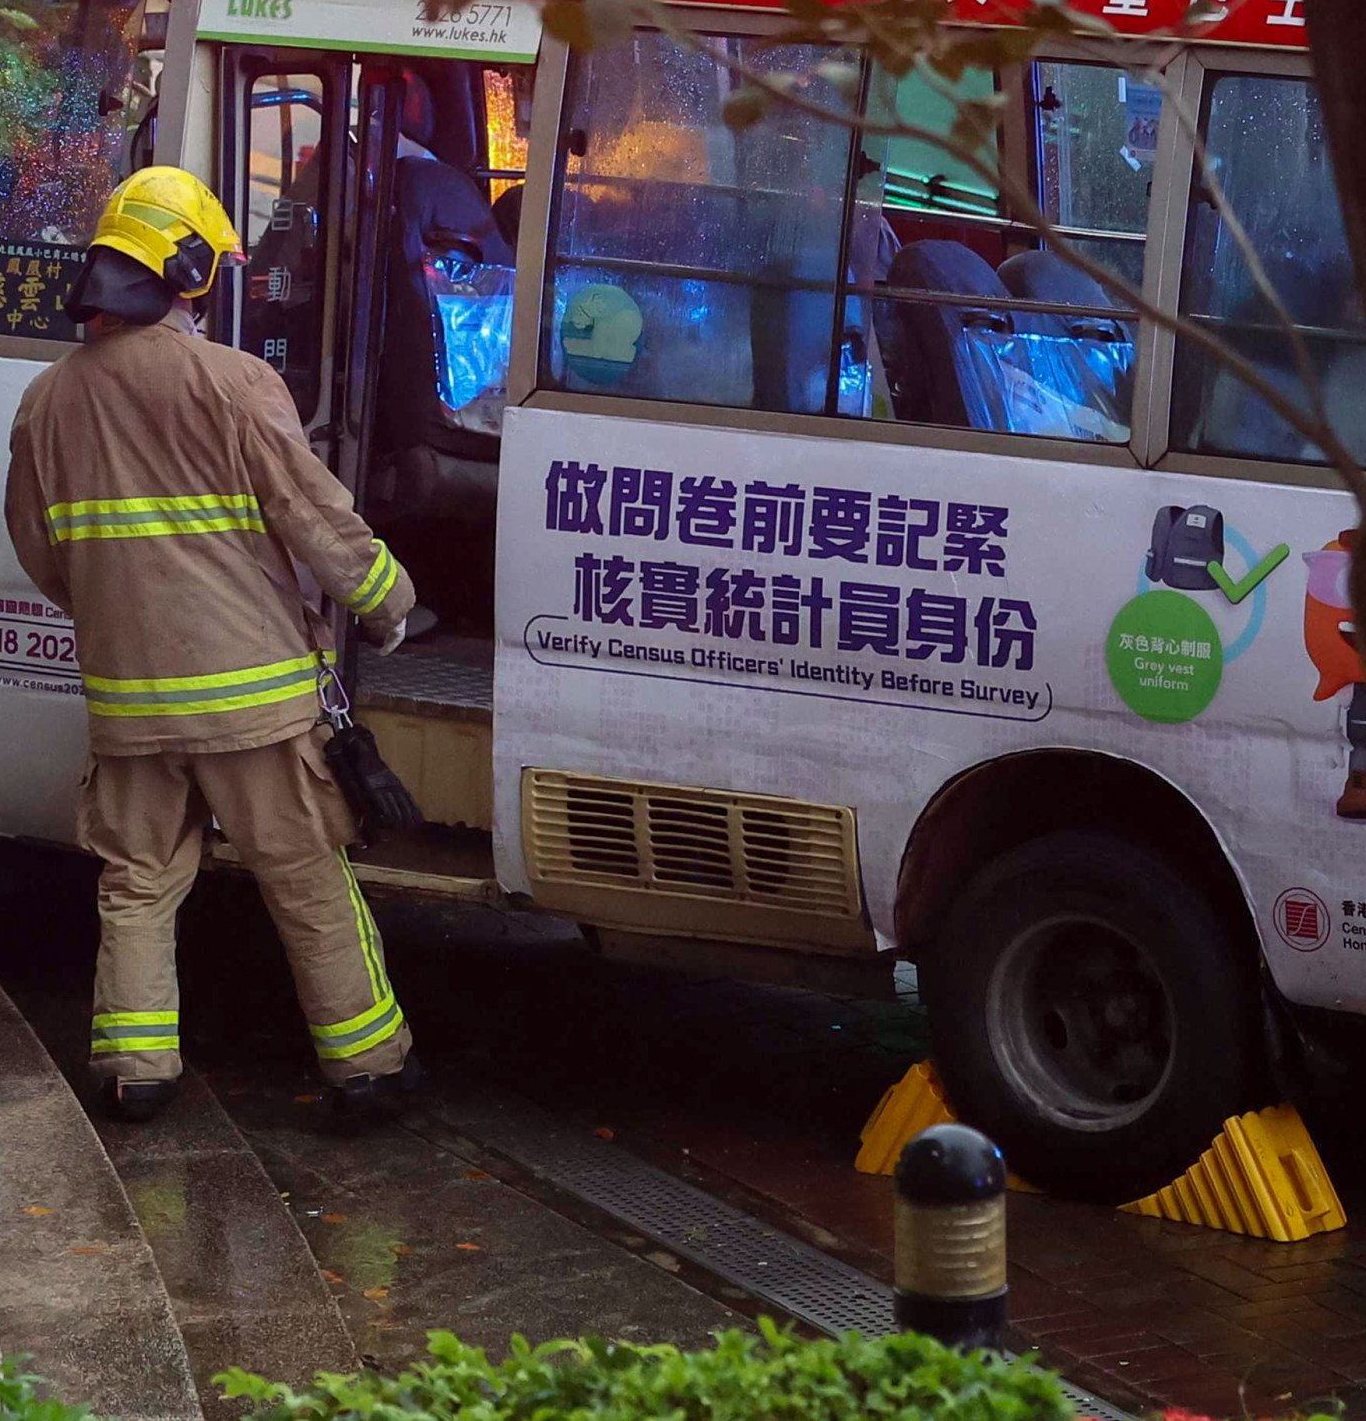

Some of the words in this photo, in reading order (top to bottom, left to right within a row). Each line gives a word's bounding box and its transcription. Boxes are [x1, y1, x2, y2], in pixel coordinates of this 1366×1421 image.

[466, 3, 513, 27] 5771
[411, 25, 508, 44] www.lukes.hk
[6, 308, 50, 331] 中心
[544, 460, 1010, 578] 做問卷前要記緊
[572, 552, 1038, 672] 核實統計員身份
[26, 632, 75, 663] 202
[1119, 633, 1211, 660] 灰色背心制服
[537, 630, 602, 659] Verify
[608, 638, 685, 665] Census
[691, 647, 784, 676] Officers'
[790, 659, 875, 691] Identity
[881, 670, 955, 697] Before
[960, 680, 1039, 710] Survey
[1134, 656, 1164, 676] Grey
[1168, 661, 1195, 676] vest
[1139, 675, 1189, 691] uniform
